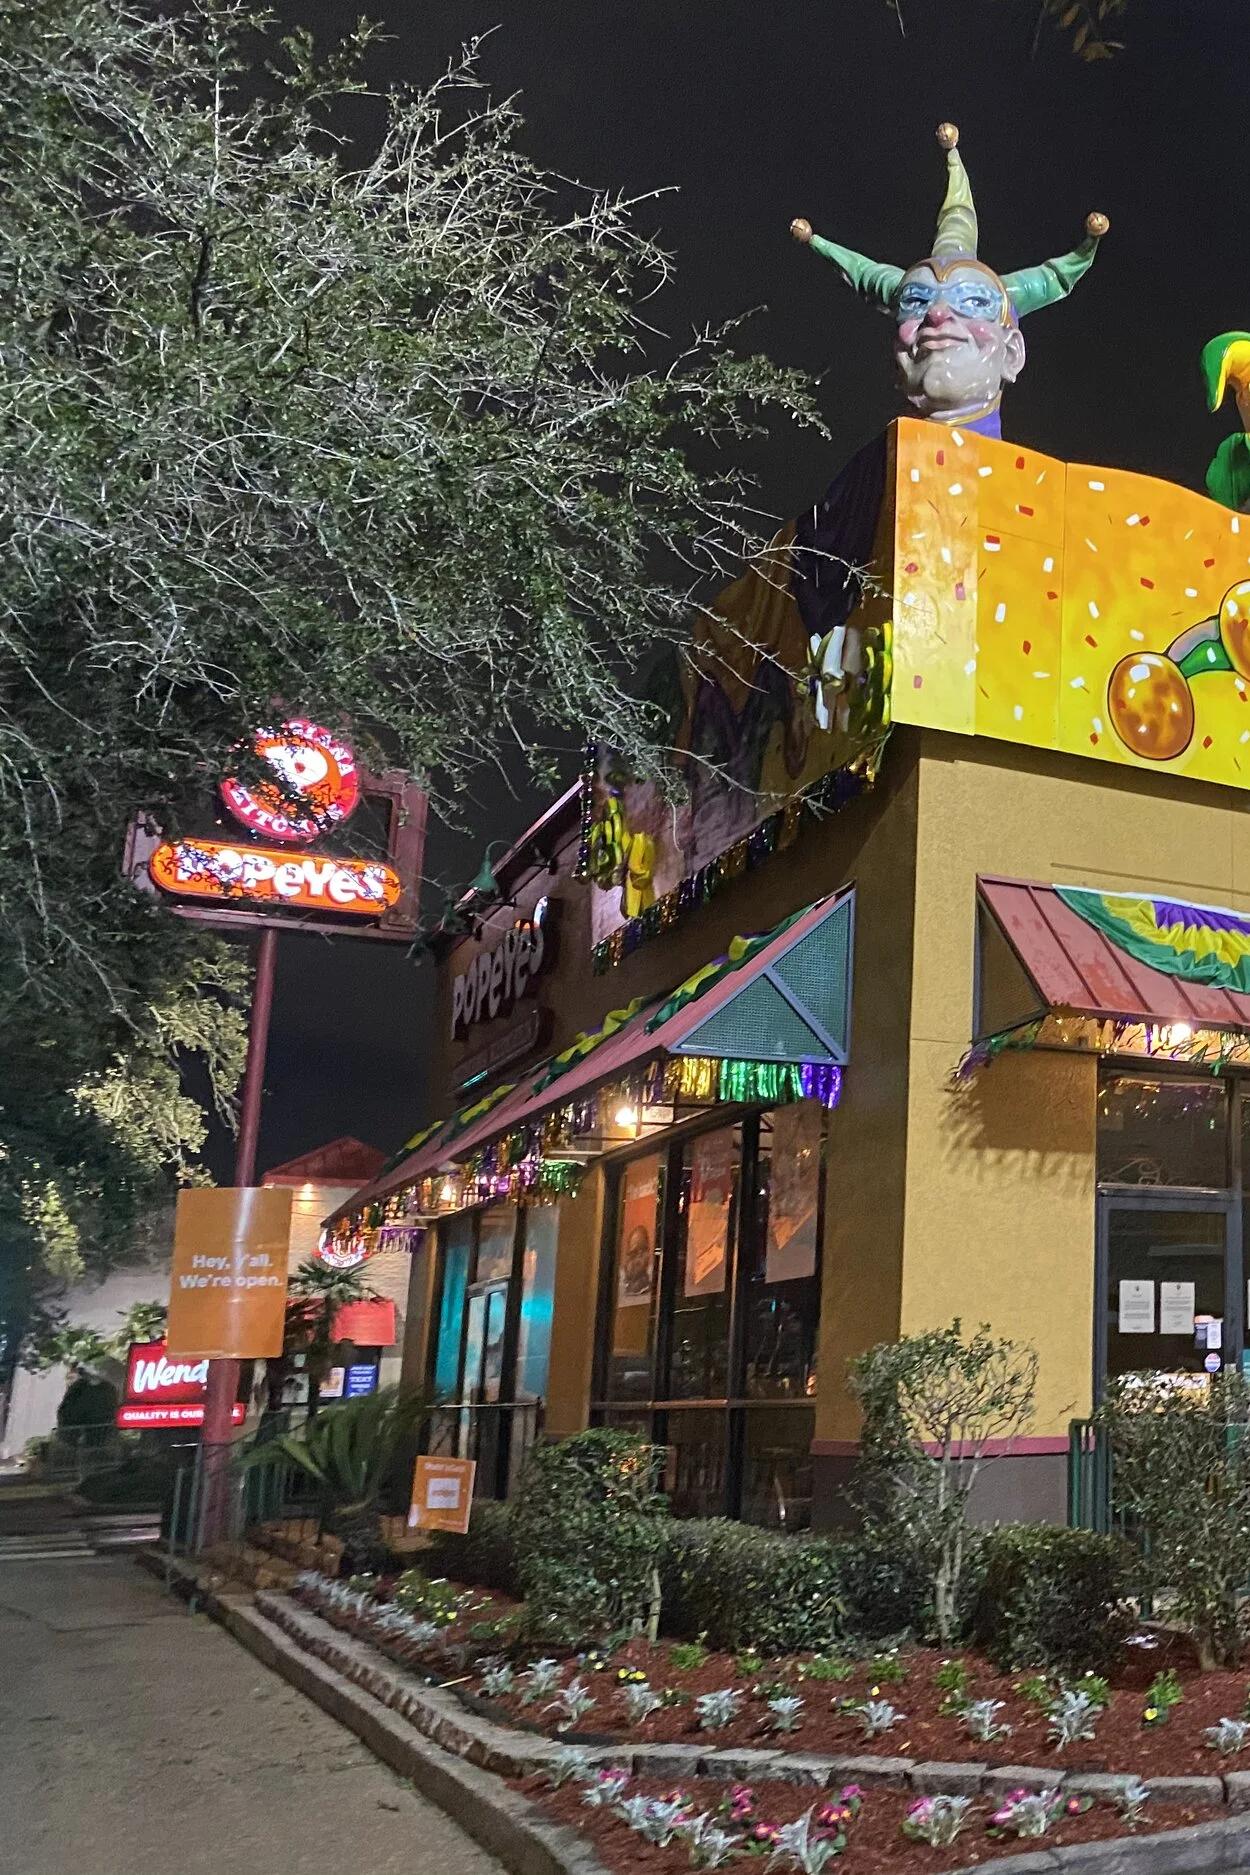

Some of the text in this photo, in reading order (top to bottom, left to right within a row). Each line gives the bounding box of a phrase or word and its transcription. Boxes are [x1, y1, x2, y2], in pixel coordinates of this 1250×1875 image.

[192, 1254, 230, 1270] Hey,
[179, 1273, 284, 1289] We're open.
[133, 1357, 210, 1393] Wend
[123, 1410, 168, 1420] QUALITY
[169, 1411, 179, 1419] IS
